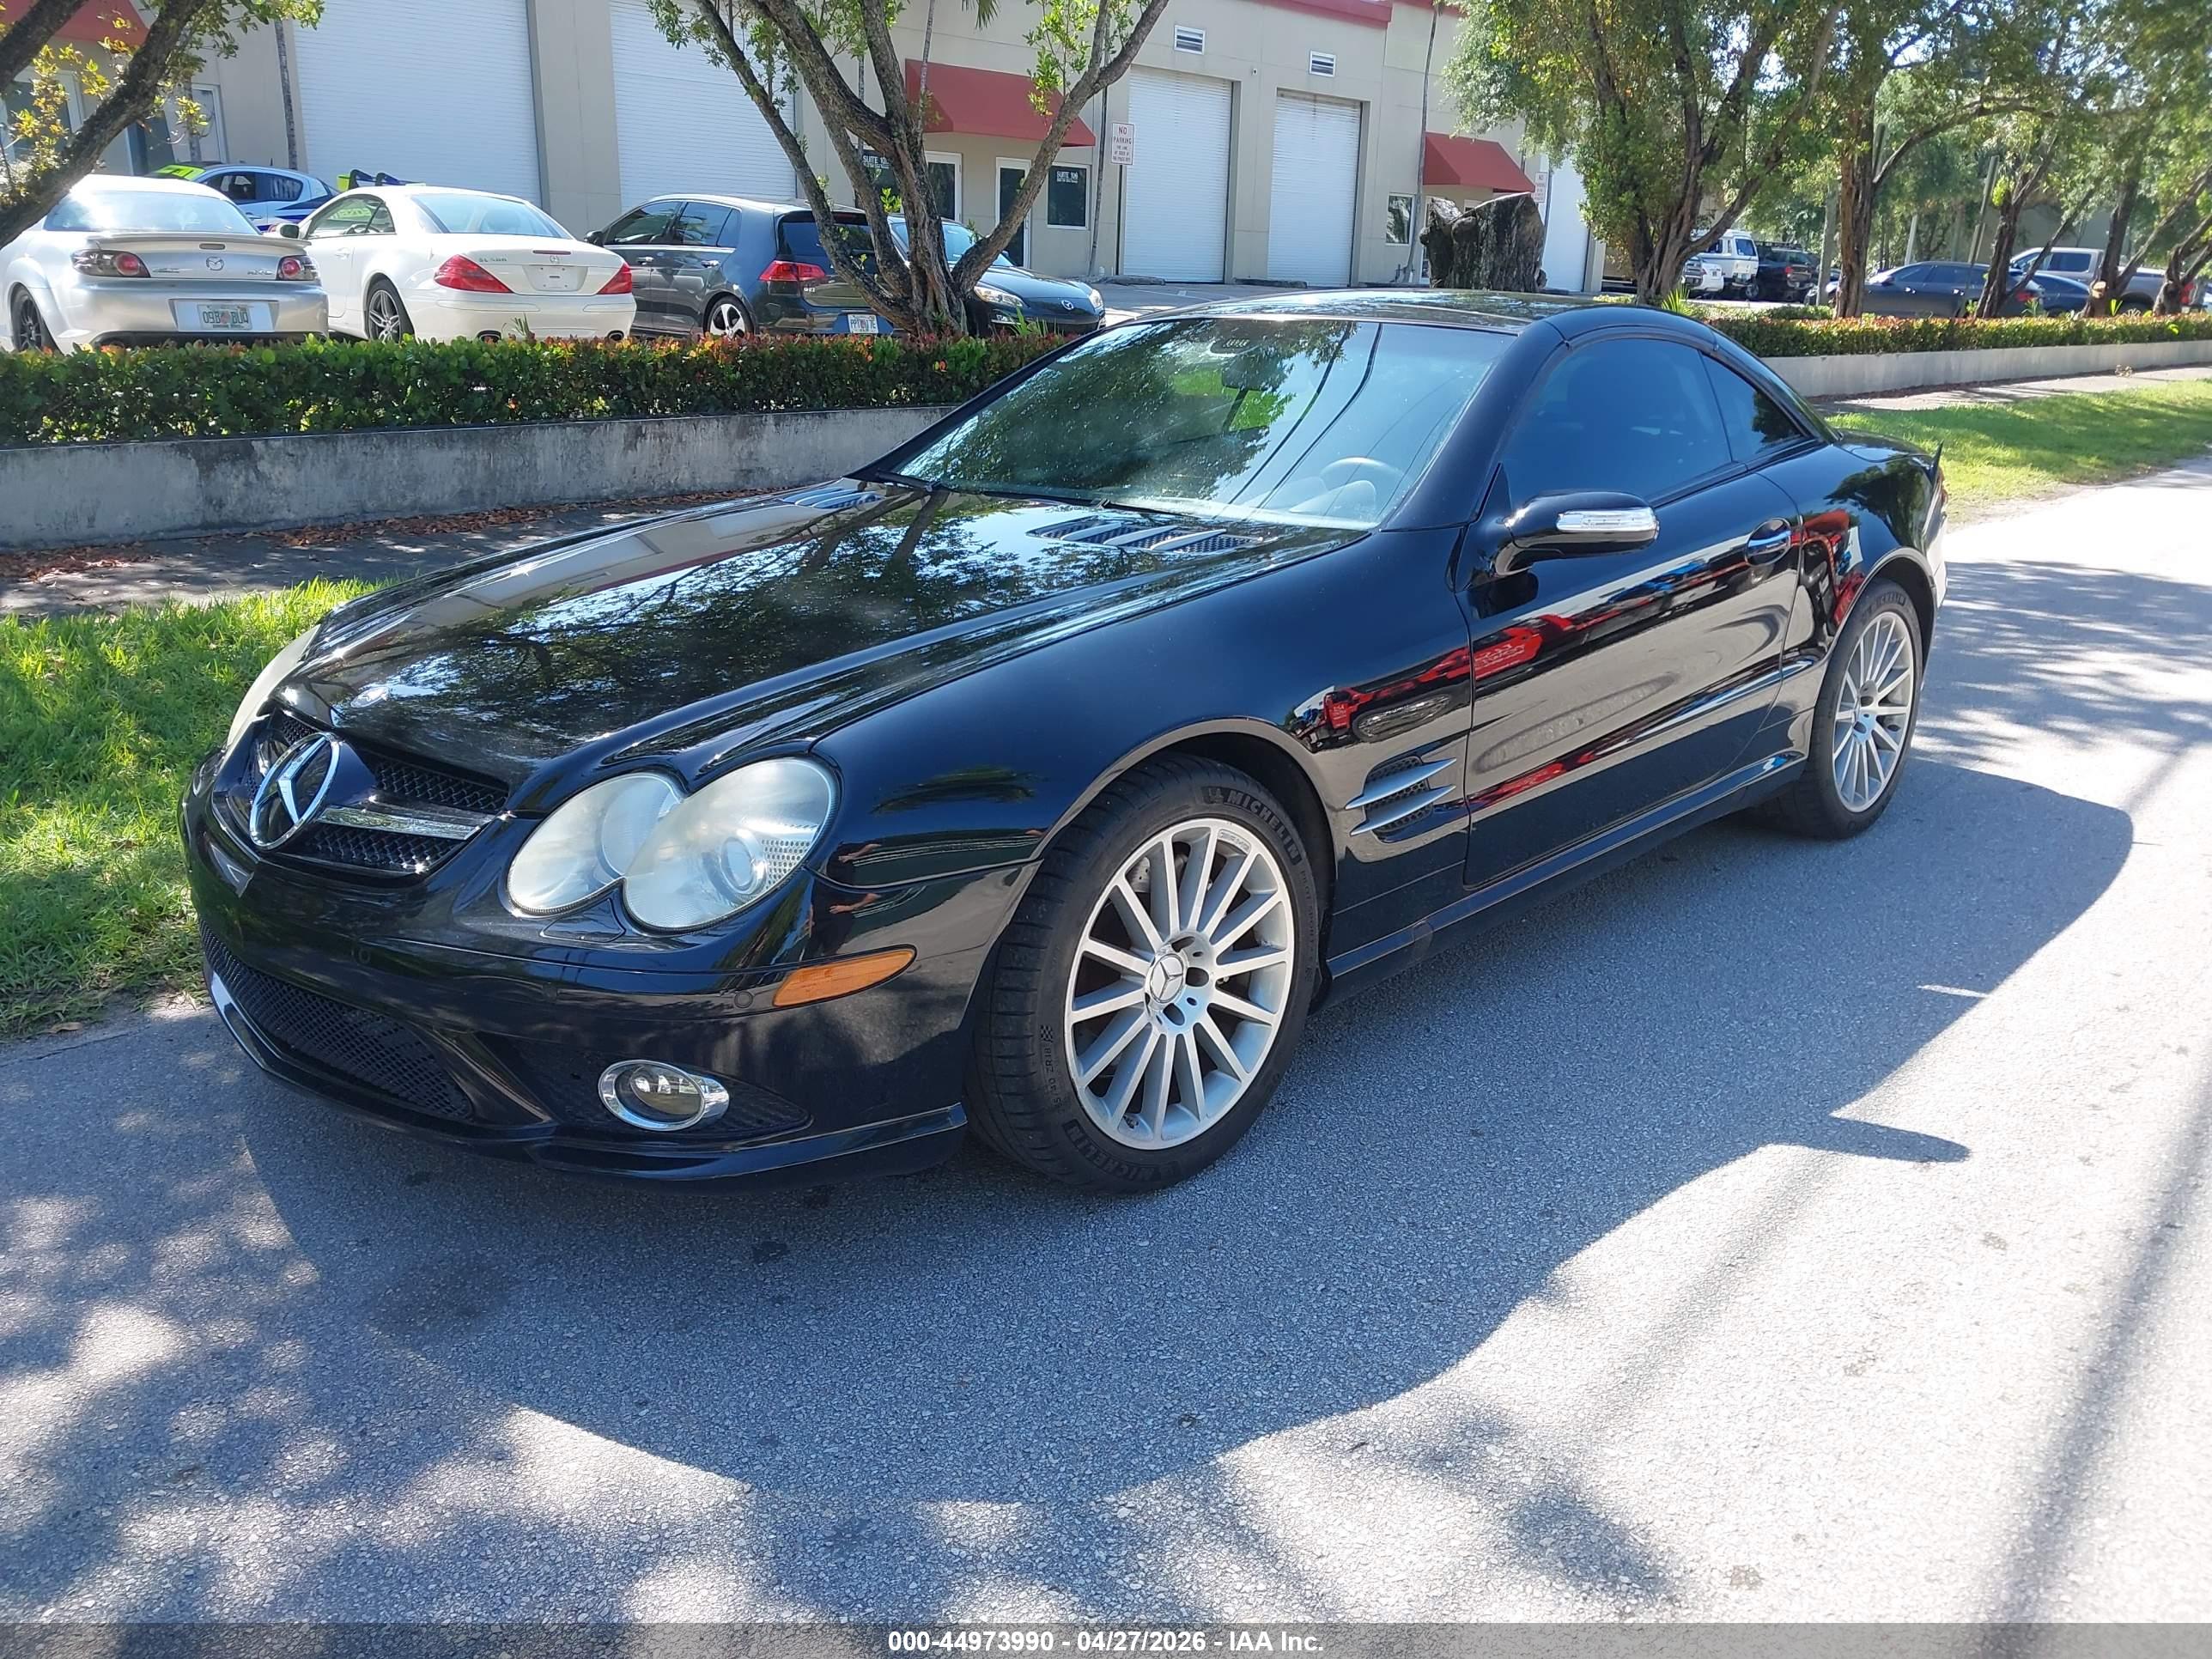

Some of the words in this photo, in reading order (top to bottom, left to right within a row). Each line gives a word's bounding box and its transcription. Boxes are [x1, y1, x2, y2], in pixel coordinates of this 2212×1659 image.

[1119, 126, 1127, 135] NO
[863, 155, 878, 164] SUITE
[1226, 789, 1299, 860] MICHELIN
